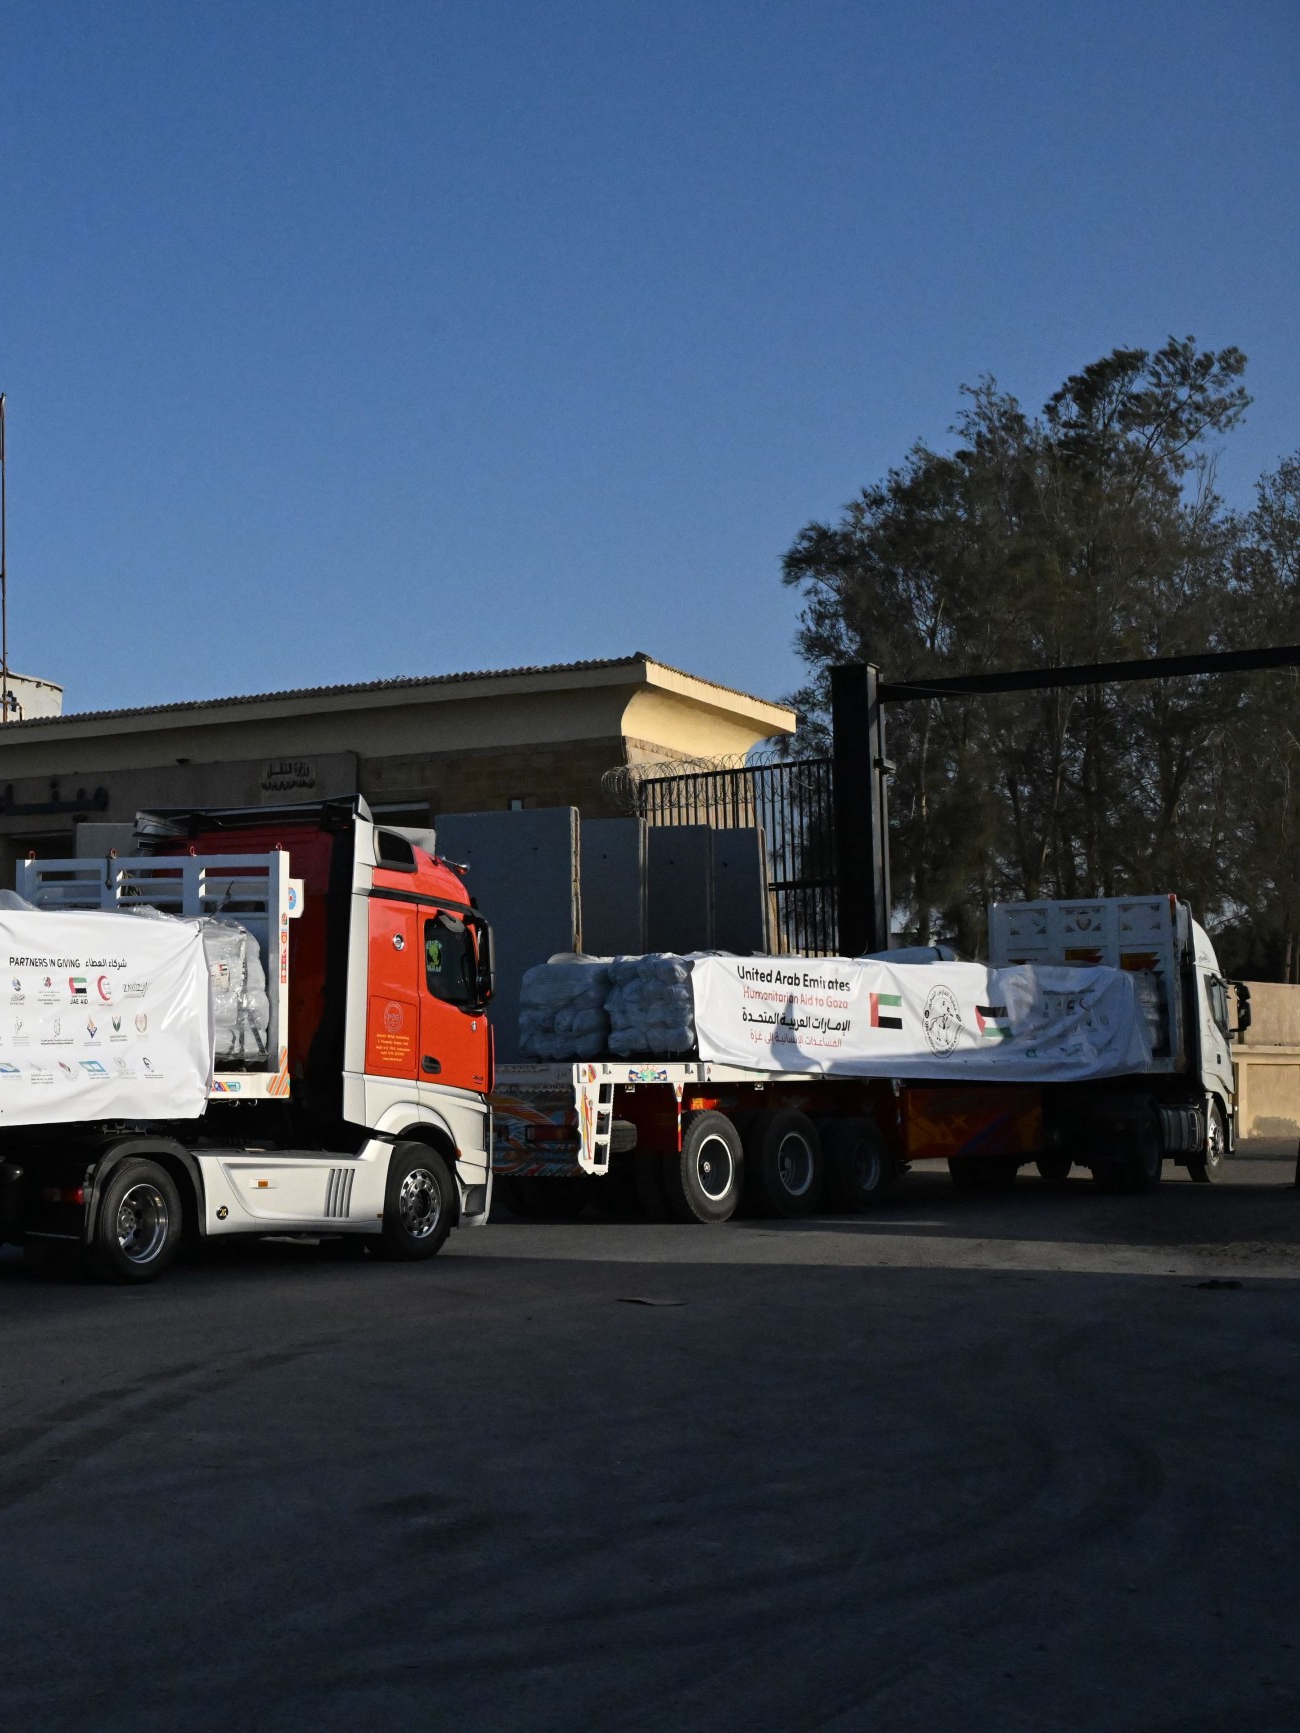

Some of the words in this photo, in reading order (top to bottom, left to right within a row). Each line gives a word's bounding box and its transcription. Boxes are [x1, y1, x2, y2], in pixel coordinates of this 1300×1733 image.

[9, 956, 49, 967] PARTNERS
[57, 958, 81, 968] GIVING
[737, 965, 773, 983] United
[774, 970, 801, 987] Arab
[802, 973, 851, 992] Emirates
[743, 986, 799, 1004] Humanitarian
[800, 993, 814, 1006] Aid
[815, 995, 824, 1007] to
[826, 997, 848, 1009] Gaza
[742, 1006, 779, 1025] المتحدة
[779, 1012, 811, 1031] العربية
[812, 1016, 851, 1037] الإمارات
